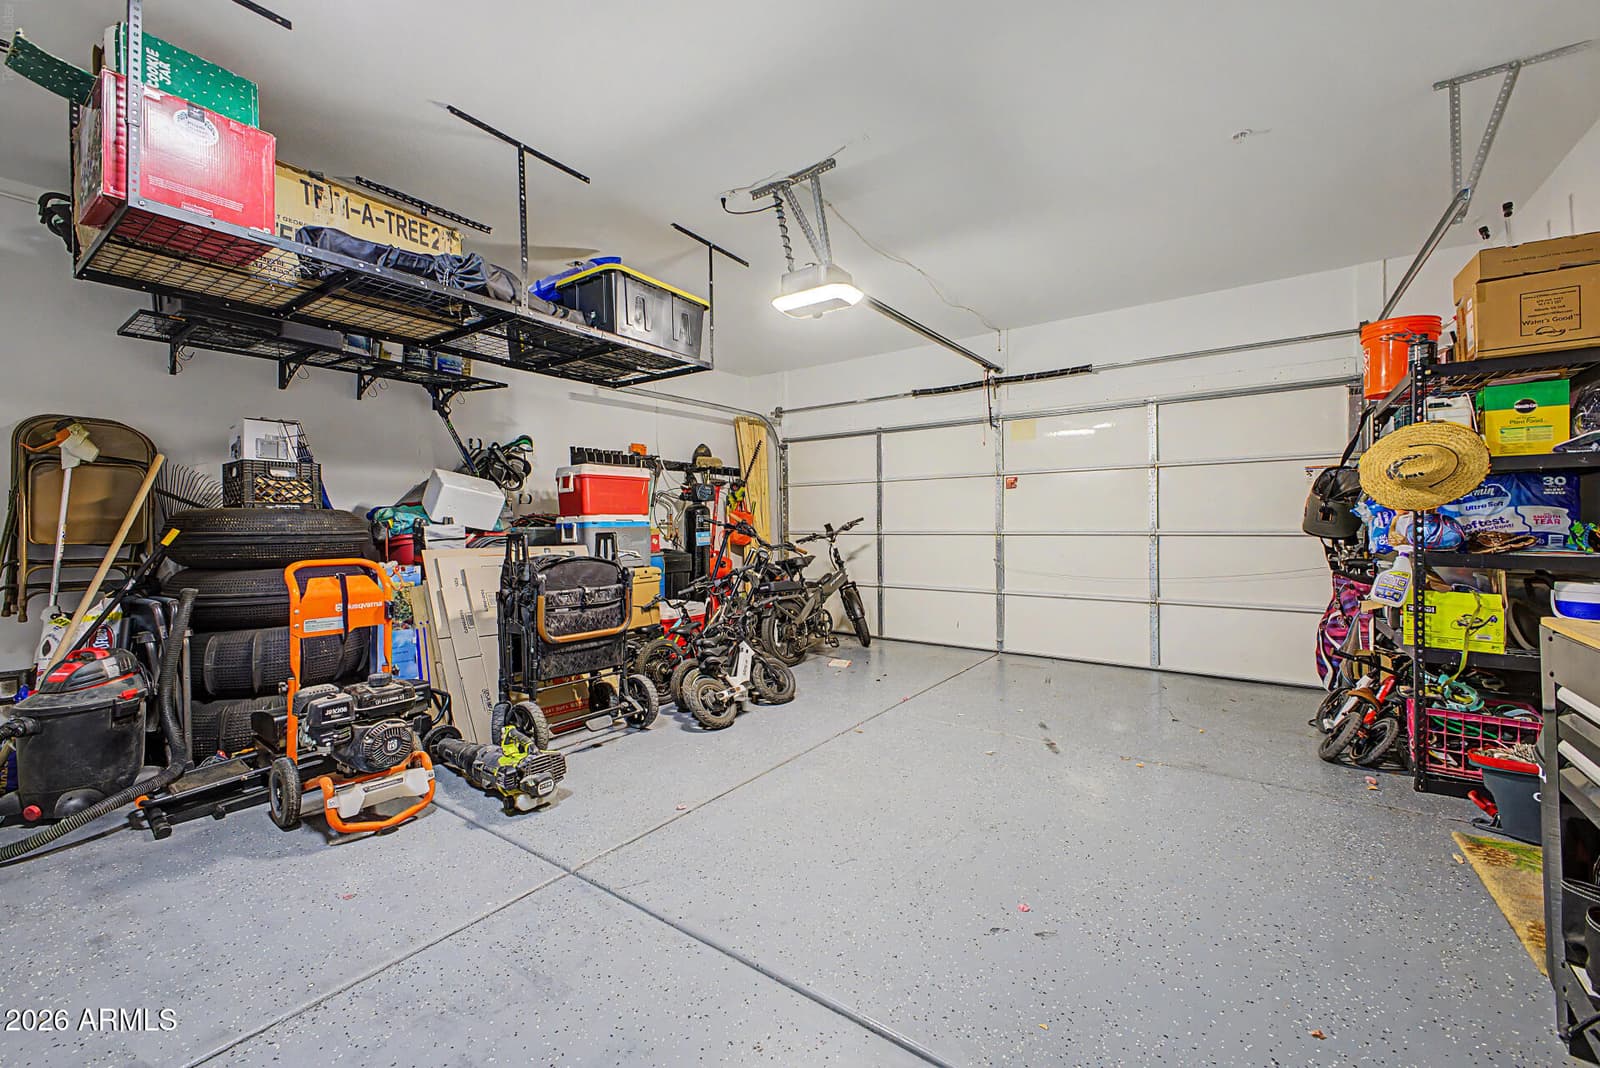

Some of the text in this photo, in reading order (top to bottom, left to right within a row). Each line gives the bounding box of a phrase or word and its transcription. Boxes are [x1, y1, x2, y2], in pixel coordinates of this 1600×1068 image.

[146, 46, 160, 89] COOKIE
[159, 61, 172, 86] JAR
[1542, 475, 1566, 486] 30
[1533, 518, 1561, 526] TEAR
